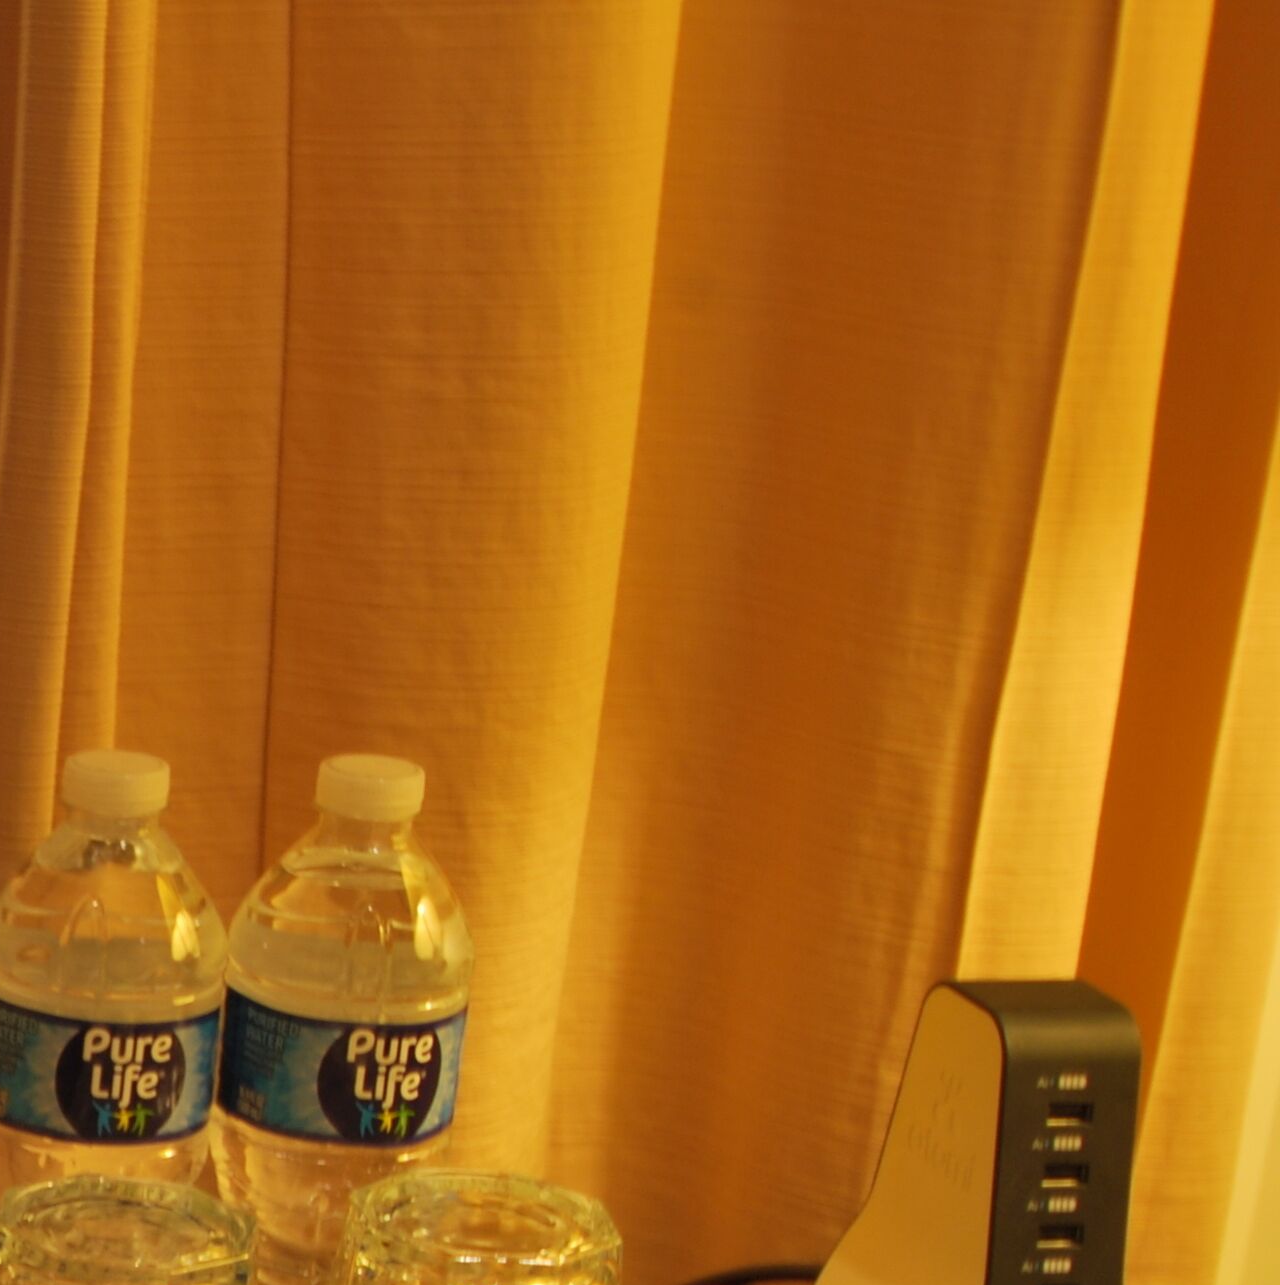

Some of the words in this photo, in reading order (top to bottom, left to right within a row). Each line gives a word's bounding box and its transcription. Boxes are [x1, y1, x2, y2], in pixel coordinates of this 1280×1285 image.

[82, 1028, 172, 1065] Pure
[347, 1028, 433, 1065] Pure
[91, 1064, 159, 1109] Life
[355, 1064, 421, 1109] Life
